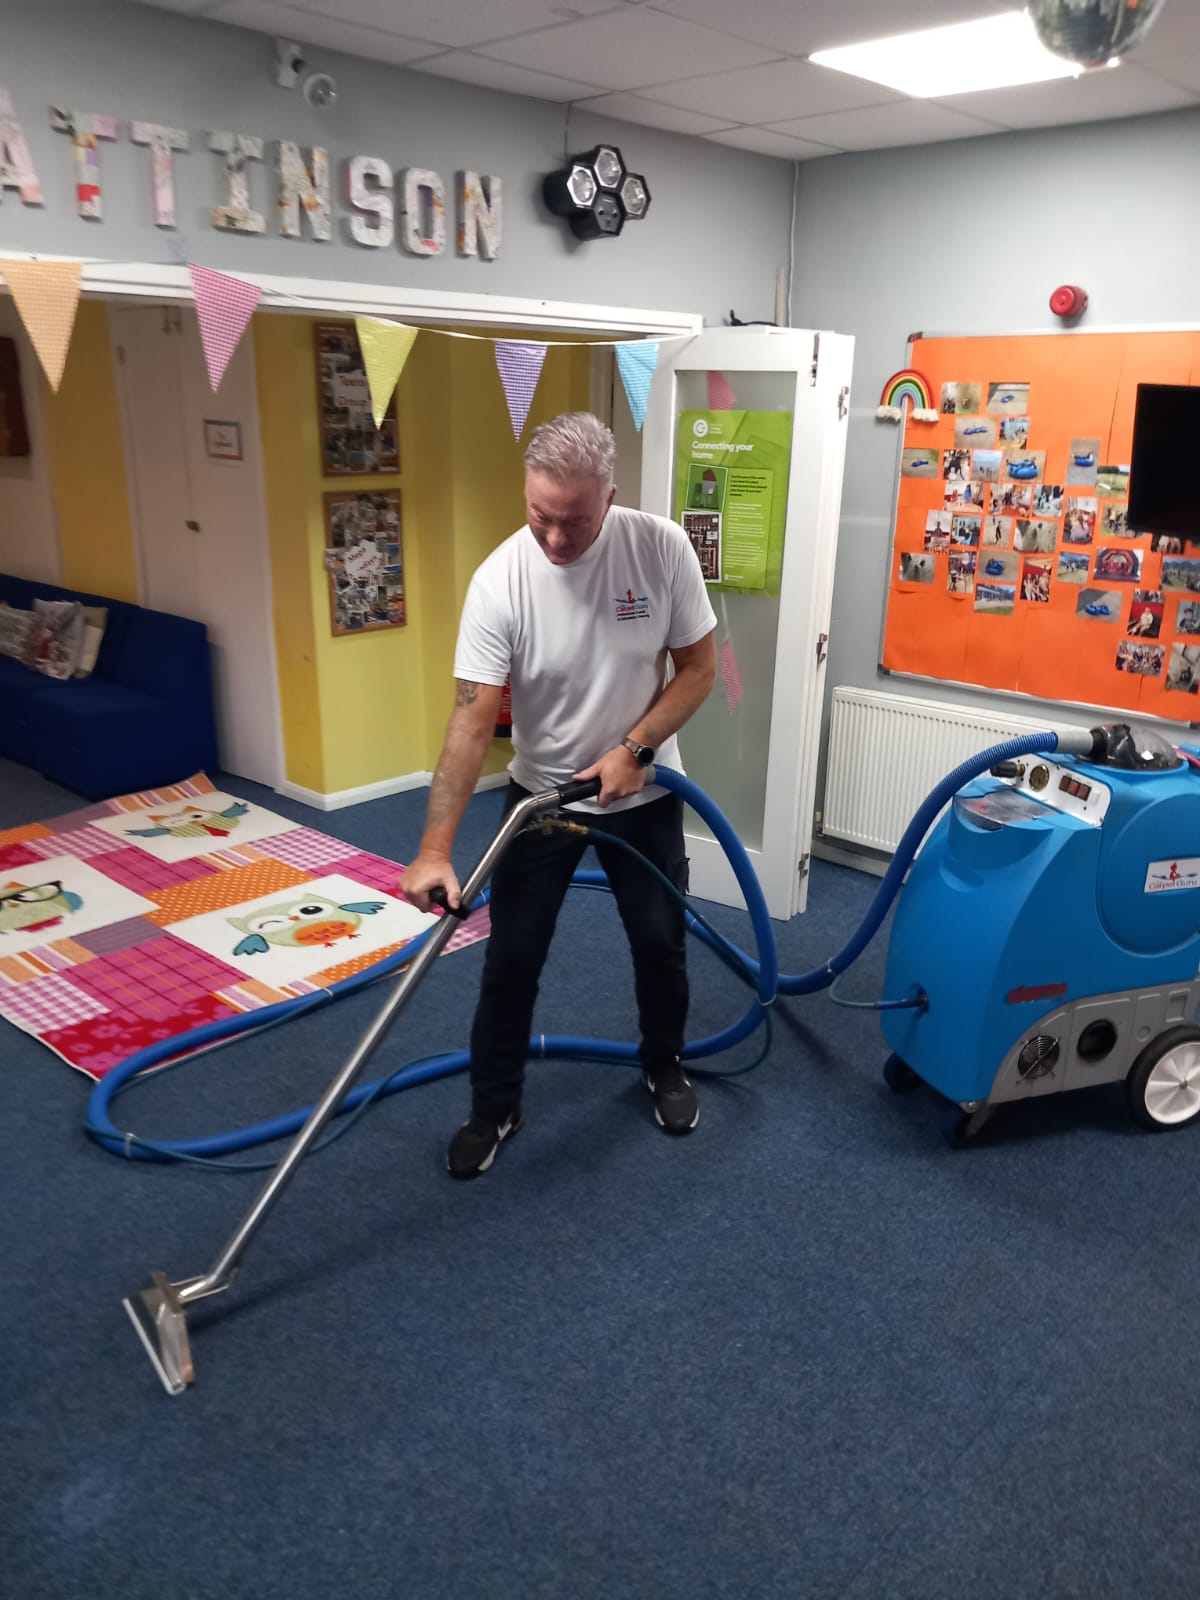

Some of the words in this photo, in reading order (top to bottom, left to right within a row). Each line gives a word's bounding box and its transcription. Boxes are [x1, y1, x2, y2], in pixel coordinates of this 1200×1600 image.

[692, 440, 734, 453] Connecting
[734, 444, 754, 453] your
[691, 450, 714, 459] home
